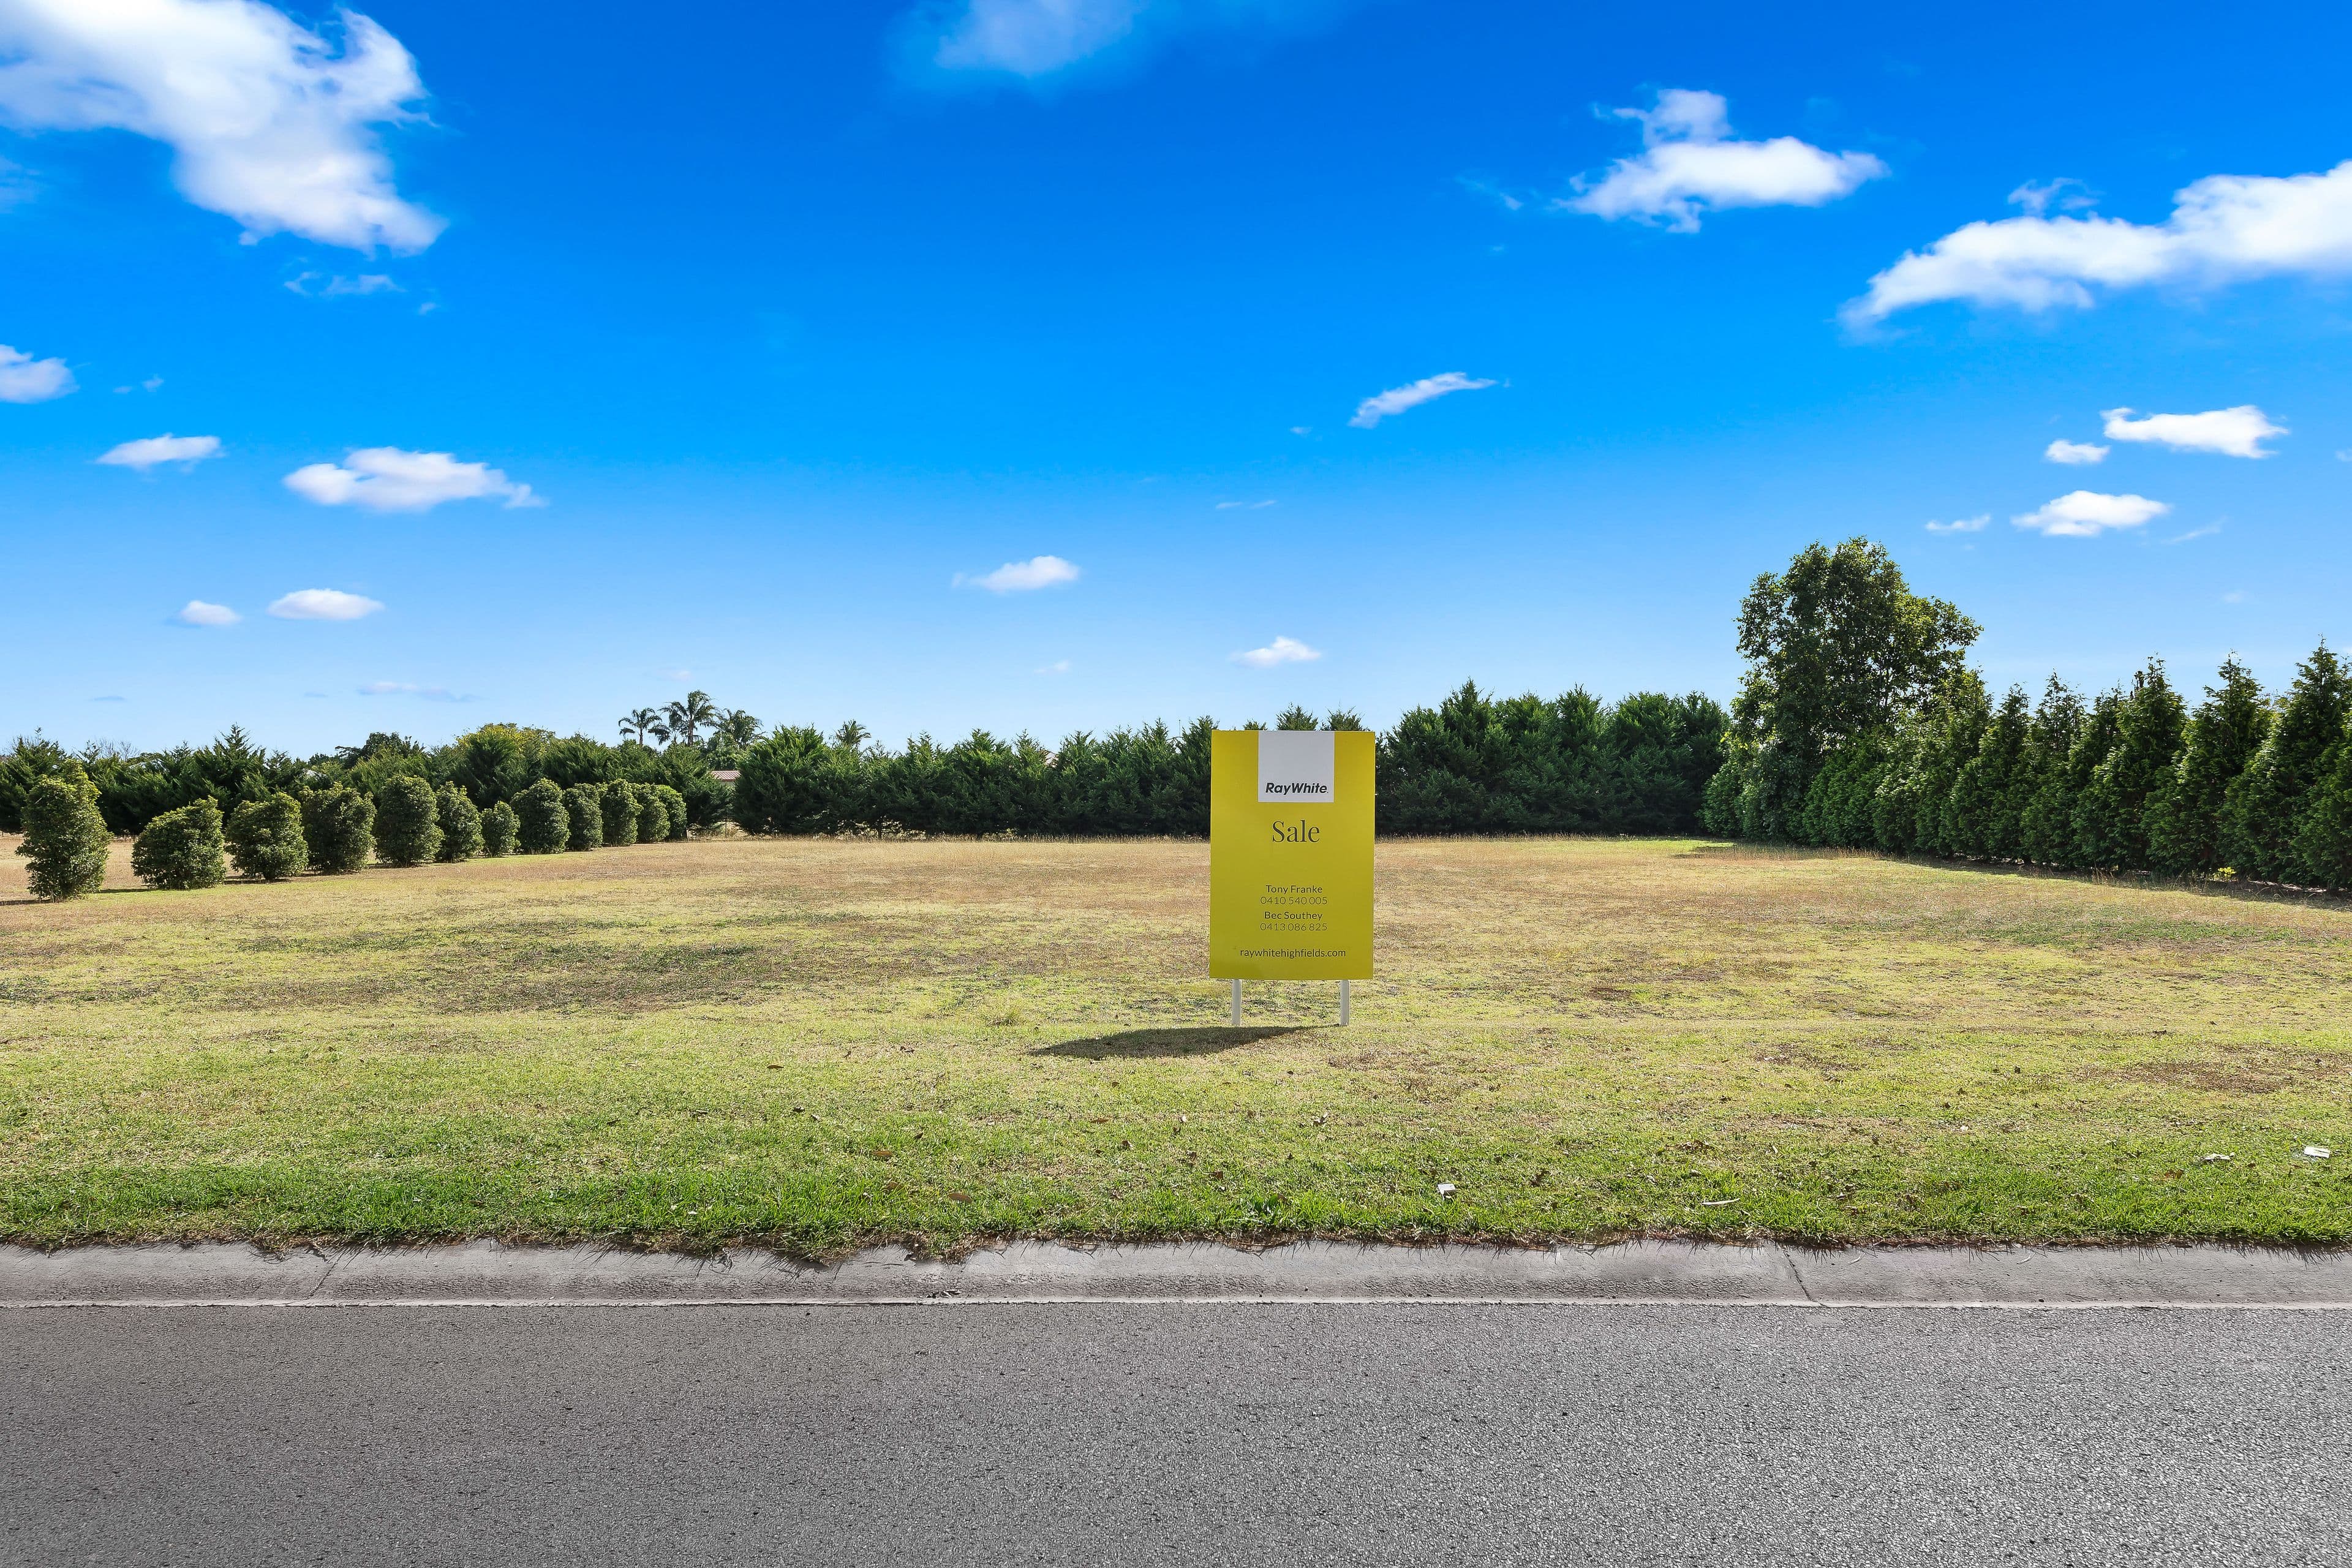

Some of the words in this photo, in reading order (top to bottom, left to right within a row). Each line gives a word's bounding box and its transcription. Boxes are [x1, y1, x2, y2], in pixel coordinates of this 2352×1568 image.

[1272, 820, 1320, 843] Sale
[1265, 884, 1288, 895] Tony
[1284, 911, 1323, 921] Southey
[1260, 922, 1286, 931] 0413
[1287, 922, 1306, 931] 086
[1309, 922, 1327, 931] 825
[1240, 948, 1346, 959] raywhitehighfields.com
